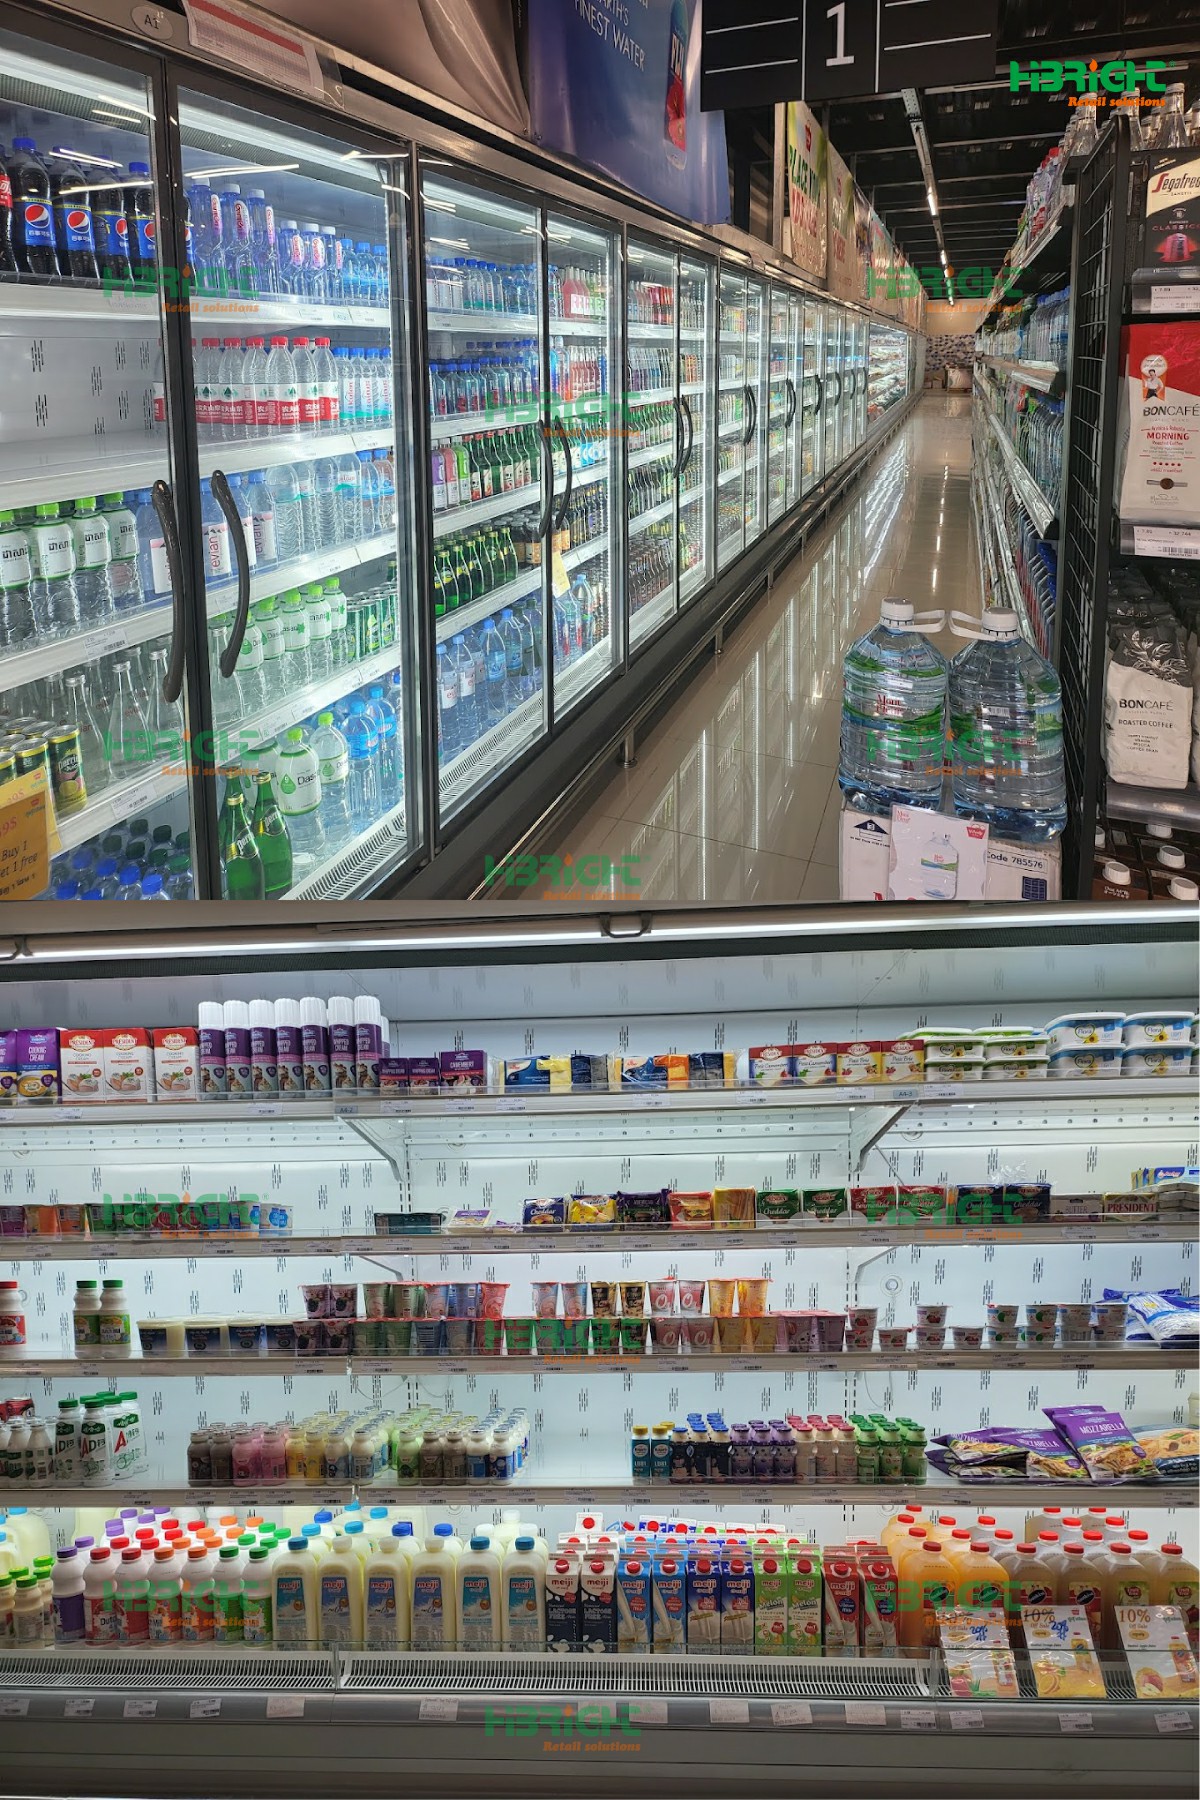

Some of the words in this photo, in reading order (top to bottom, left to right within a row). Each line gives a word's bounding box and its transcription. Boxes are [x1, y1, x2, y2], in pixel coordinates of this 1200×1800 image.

[825, 3, 855, 67] 1
[612, 24, 646, 71] WATER
[1143, 403, 1200, 417] BONCAFÉ
[1146, 431, 1190, 441] MORNING
[208, 534, 221, 568] evian
[1119, 698, 1174, 711] BONCAFÉ
[1148, 721, 1174, 729] COFFEE
[2, 847, 20, 860] Buy
[20, 853, 38, 872] free
[1011, 856, 1043, 869] 785576
[28, 1046, 47, 1055] COOKING
[29, 1054, 45, 1062] CREAM
[1014, 1200, 1042, 1208] Cheddar
[530, 1208, 556, 1216] Cheddar
[764, 1208, 790, 1216] Cheddar
[1064, 1206, 1088, 1214] BUTTER
[1080, 1422, 1125, 1435] MOZZARELLA
[279, 1580, 300, 1592] meiji
[322, 1580, 345, 1592] meiji
[369, 1580, 393, 1592] meiji
[416, 1580, 440, 1592] meiji
[465, 1579, 488, 1591] meiji
[510, 1580, 533, 1592] meiji
[551, 1578, 574, 1588] meiji
[586, 1578, 609, 1588] meiji
[622, 1580, 646, 1590] meiji
[658, 1580, 682, 1590] meiji
[692, 1579, 717, 1589] meiji
[726, 1579, 751, 1589] meiji
[762, 1578, 782, 1588] meiji
[795, 1578, 815, 1588] meiji
[830, 1581, 856, 1592] meiji
[870, 1582, 895, 1592] meiji
[759, 1599, 784, 1610] Melon
[792, 1599, 818, 1610] Melon
[1119, 1608, 1150, 1623] 10%
